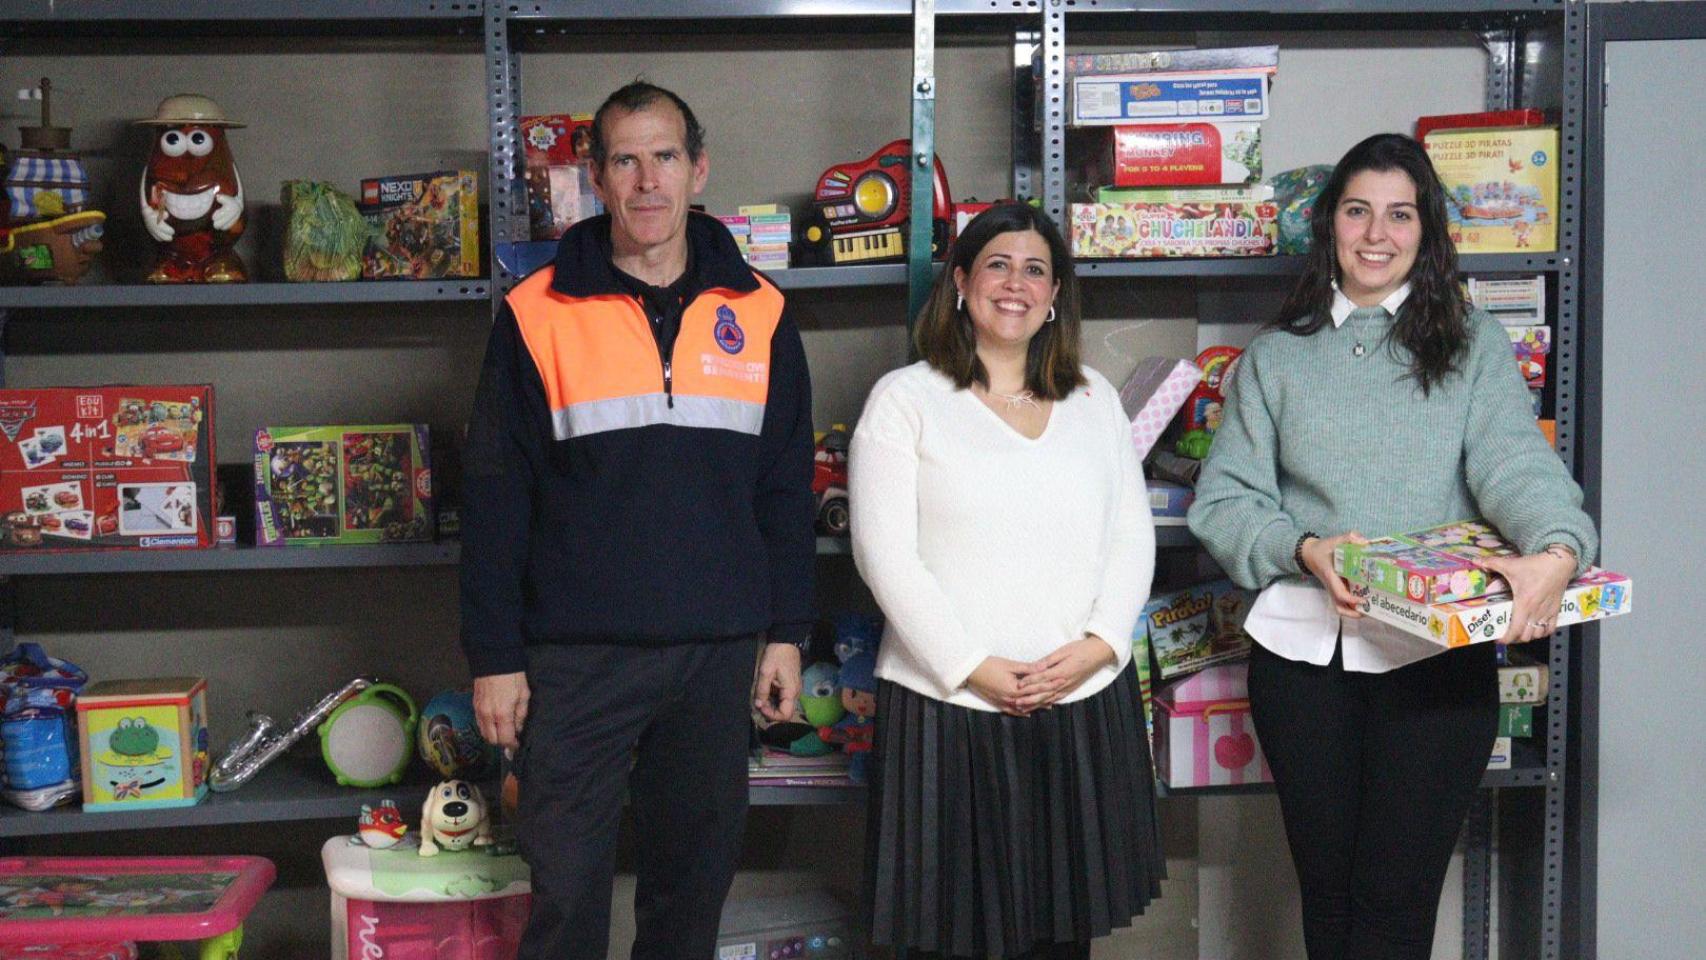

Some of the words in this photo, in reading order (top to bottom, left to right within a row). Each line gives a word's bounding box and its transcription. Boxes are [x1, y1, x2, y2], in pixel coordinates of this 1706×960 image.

[1432, 142, 1463, 150] PUZZLE
[1478, 139, 1512, 148] PIRATAS
[1432, 152, 1463, 161] PUZZLE
[380, 180, 412, 193] NEXO
[1139, 217, 1264, 239] CHUCHELANDIA
[70, 422, 84, 444] 4
[85, 423, 97, 438] in
[97, 419, 112, 439] 1
[149, 537, 197, 546] Clementoni
[1371, 594, 1379, 604] el
[1380, 597, 1427, 626] abecedario
[1467, 608, 1492, 634] Diset
[1497, 612, 1507, 625] el
